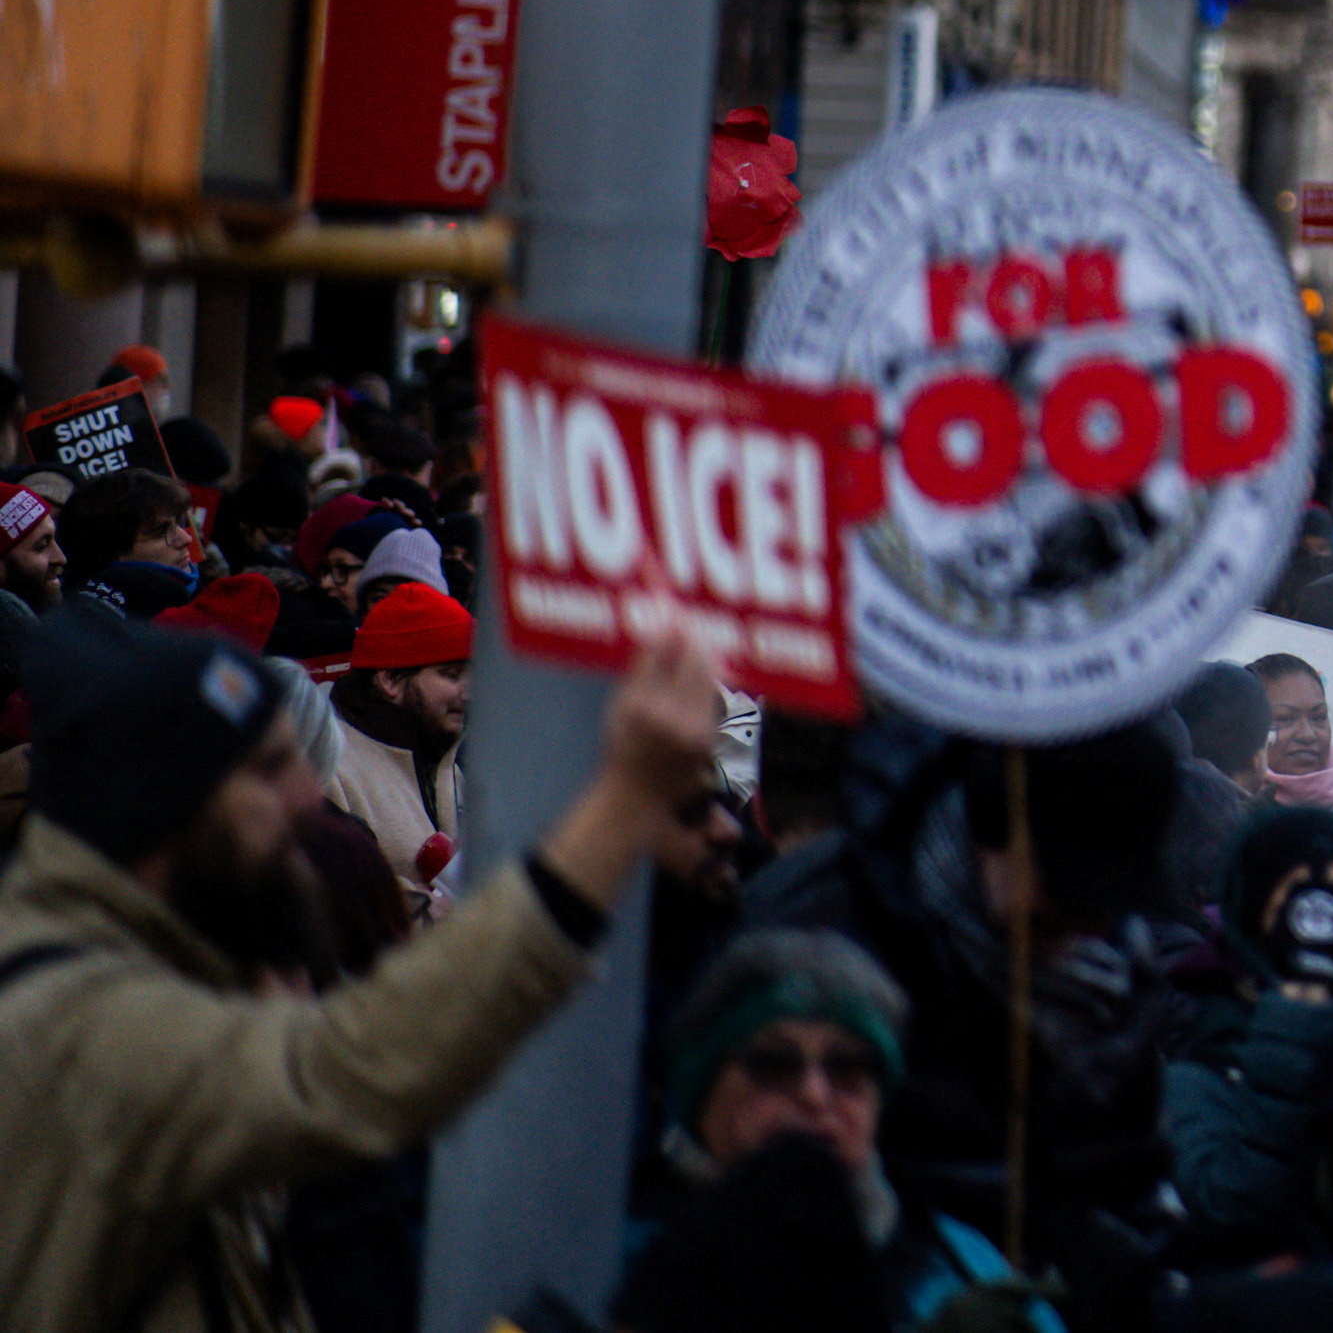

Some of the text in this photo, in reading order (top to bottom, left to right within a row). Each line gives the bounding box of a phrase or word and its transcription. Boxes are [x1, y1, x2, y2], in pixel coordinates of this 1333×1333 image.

[926, 244, 1124, 349] FOR
[54, 404, 121, 444] SHUT
[57, 424, 135, 465] DOWN
[78, 450, 129, 481] ICE!
[493, 367, 647, 585] NO
[642, 404, 834, 623] ICE!
